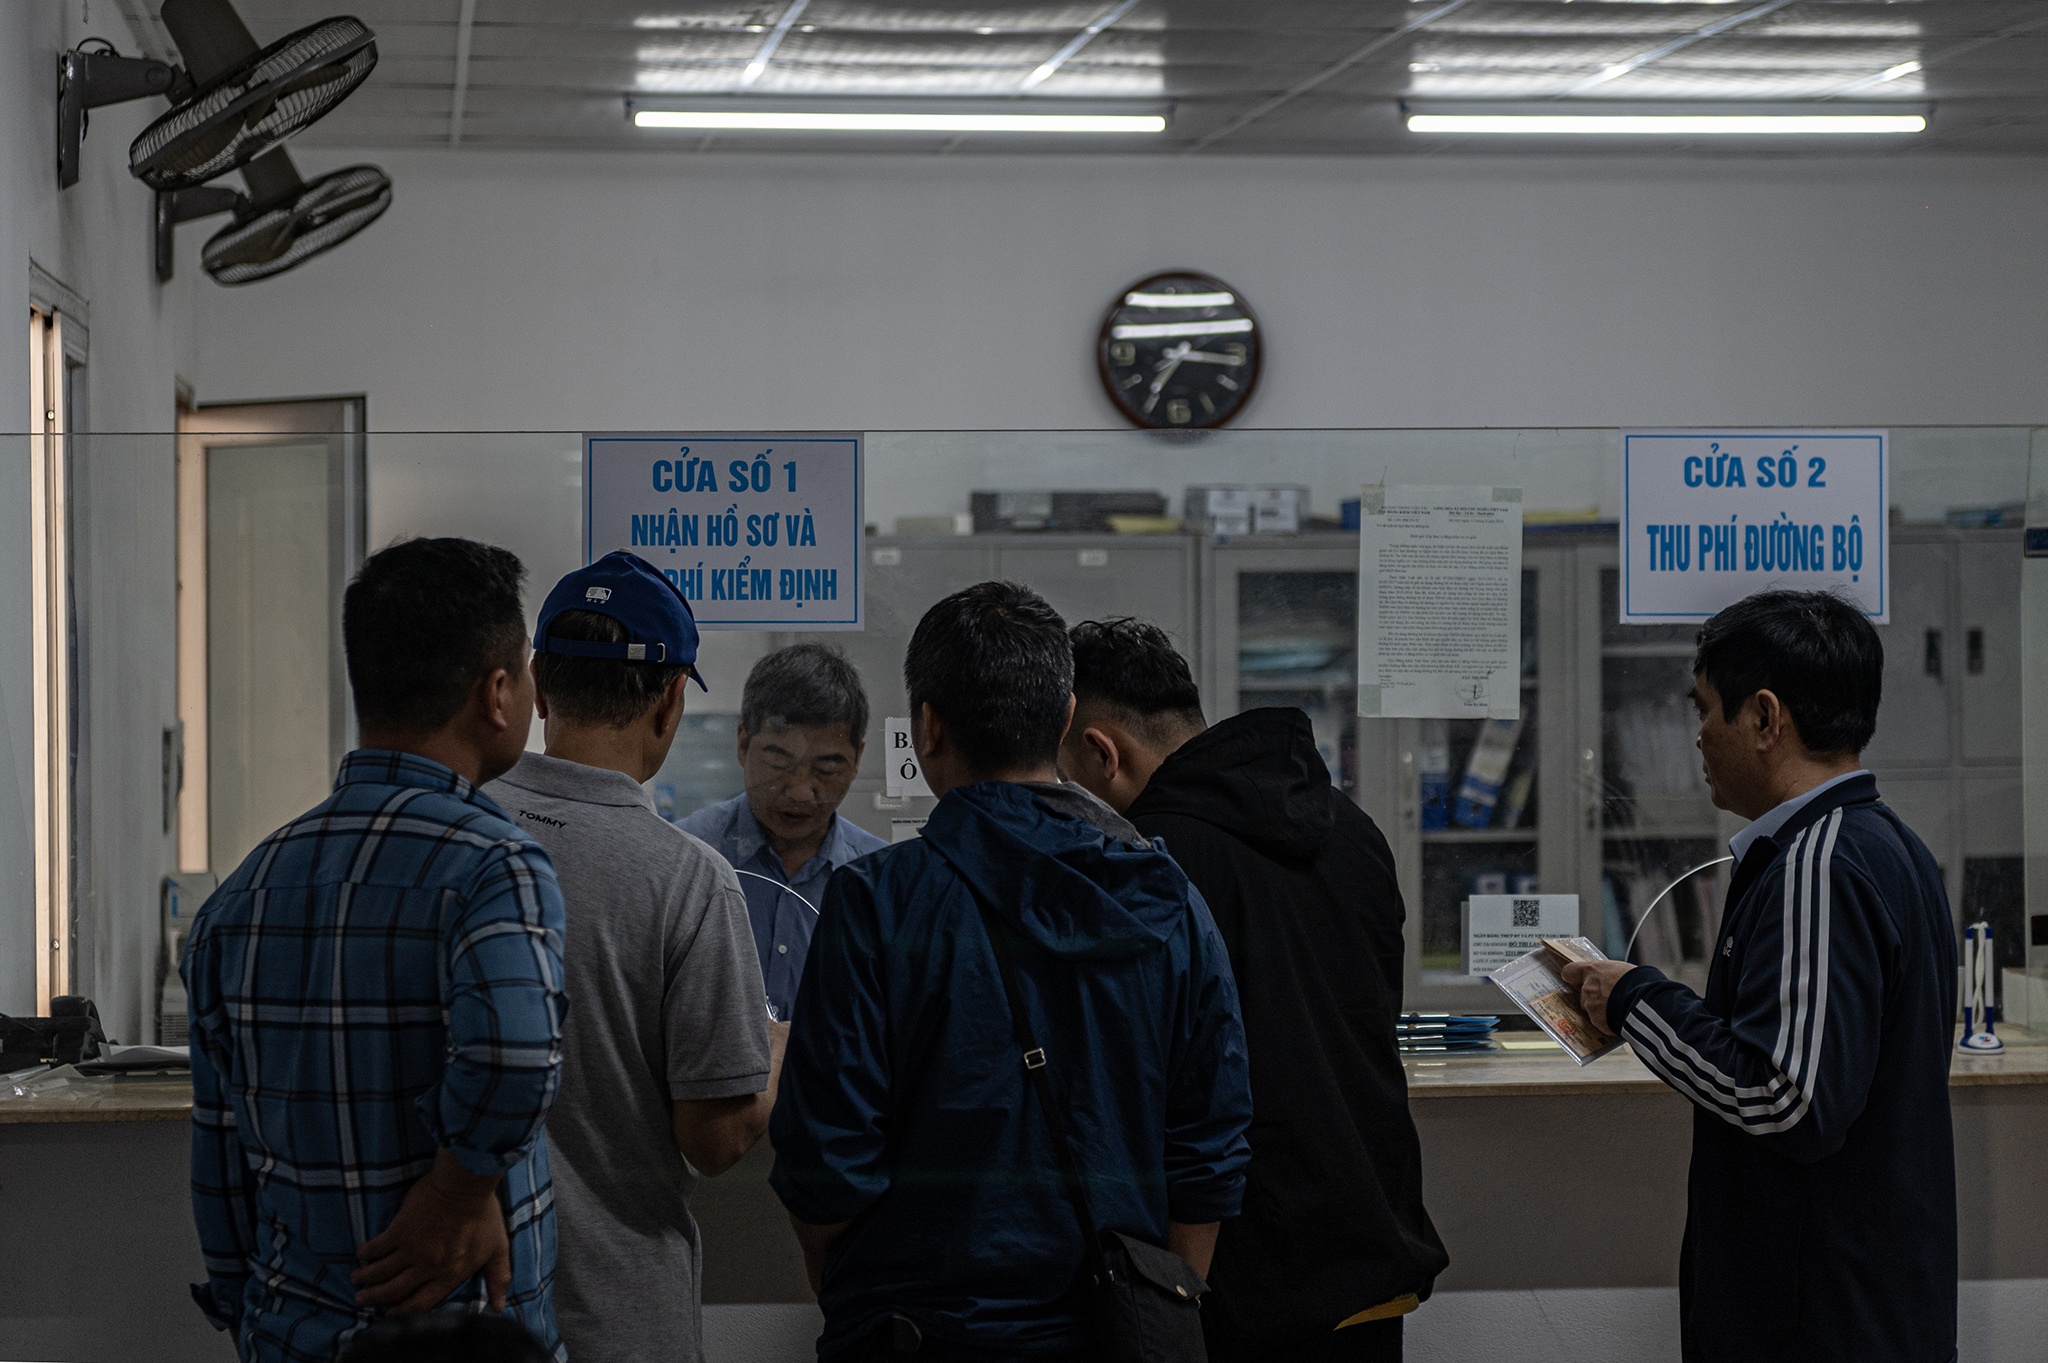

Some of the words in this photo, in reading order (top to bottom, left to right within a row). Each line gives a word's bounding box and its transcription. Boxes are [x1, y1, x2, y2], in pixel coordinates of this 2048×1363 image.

[652, 446, 718, 492] CỬA
[728, 448, 773, 492] SỐ
[783, 461, 797, 492] 1
[1684, 443, 1746, 488] CỬA
[1756, 445, 1799, 488] SỐ
[1808, 457, 1826, 488] 2
[631, 507, 699, 554] NHẬN
[707, 503, 738, 547] HỒ
[746, 512, 780, 547] SƠ
[785, 508, 816, 547] VÀ
[1647, 524, 1691, 572] THU
[1698, 514, 1738, 572] PHÍ
[1744, 511, 1825, 572] ĐƯỜNG
[1832, 514, 1863, 583] BỘ
[711, 555, 772, 601] KIỂM
[779, 568, 837, 608] ĐỊNH
[893, 731, 914, 749] B
[900, 757, 918, 780] Ô
[519, 809, 567, 829] TOMMY
